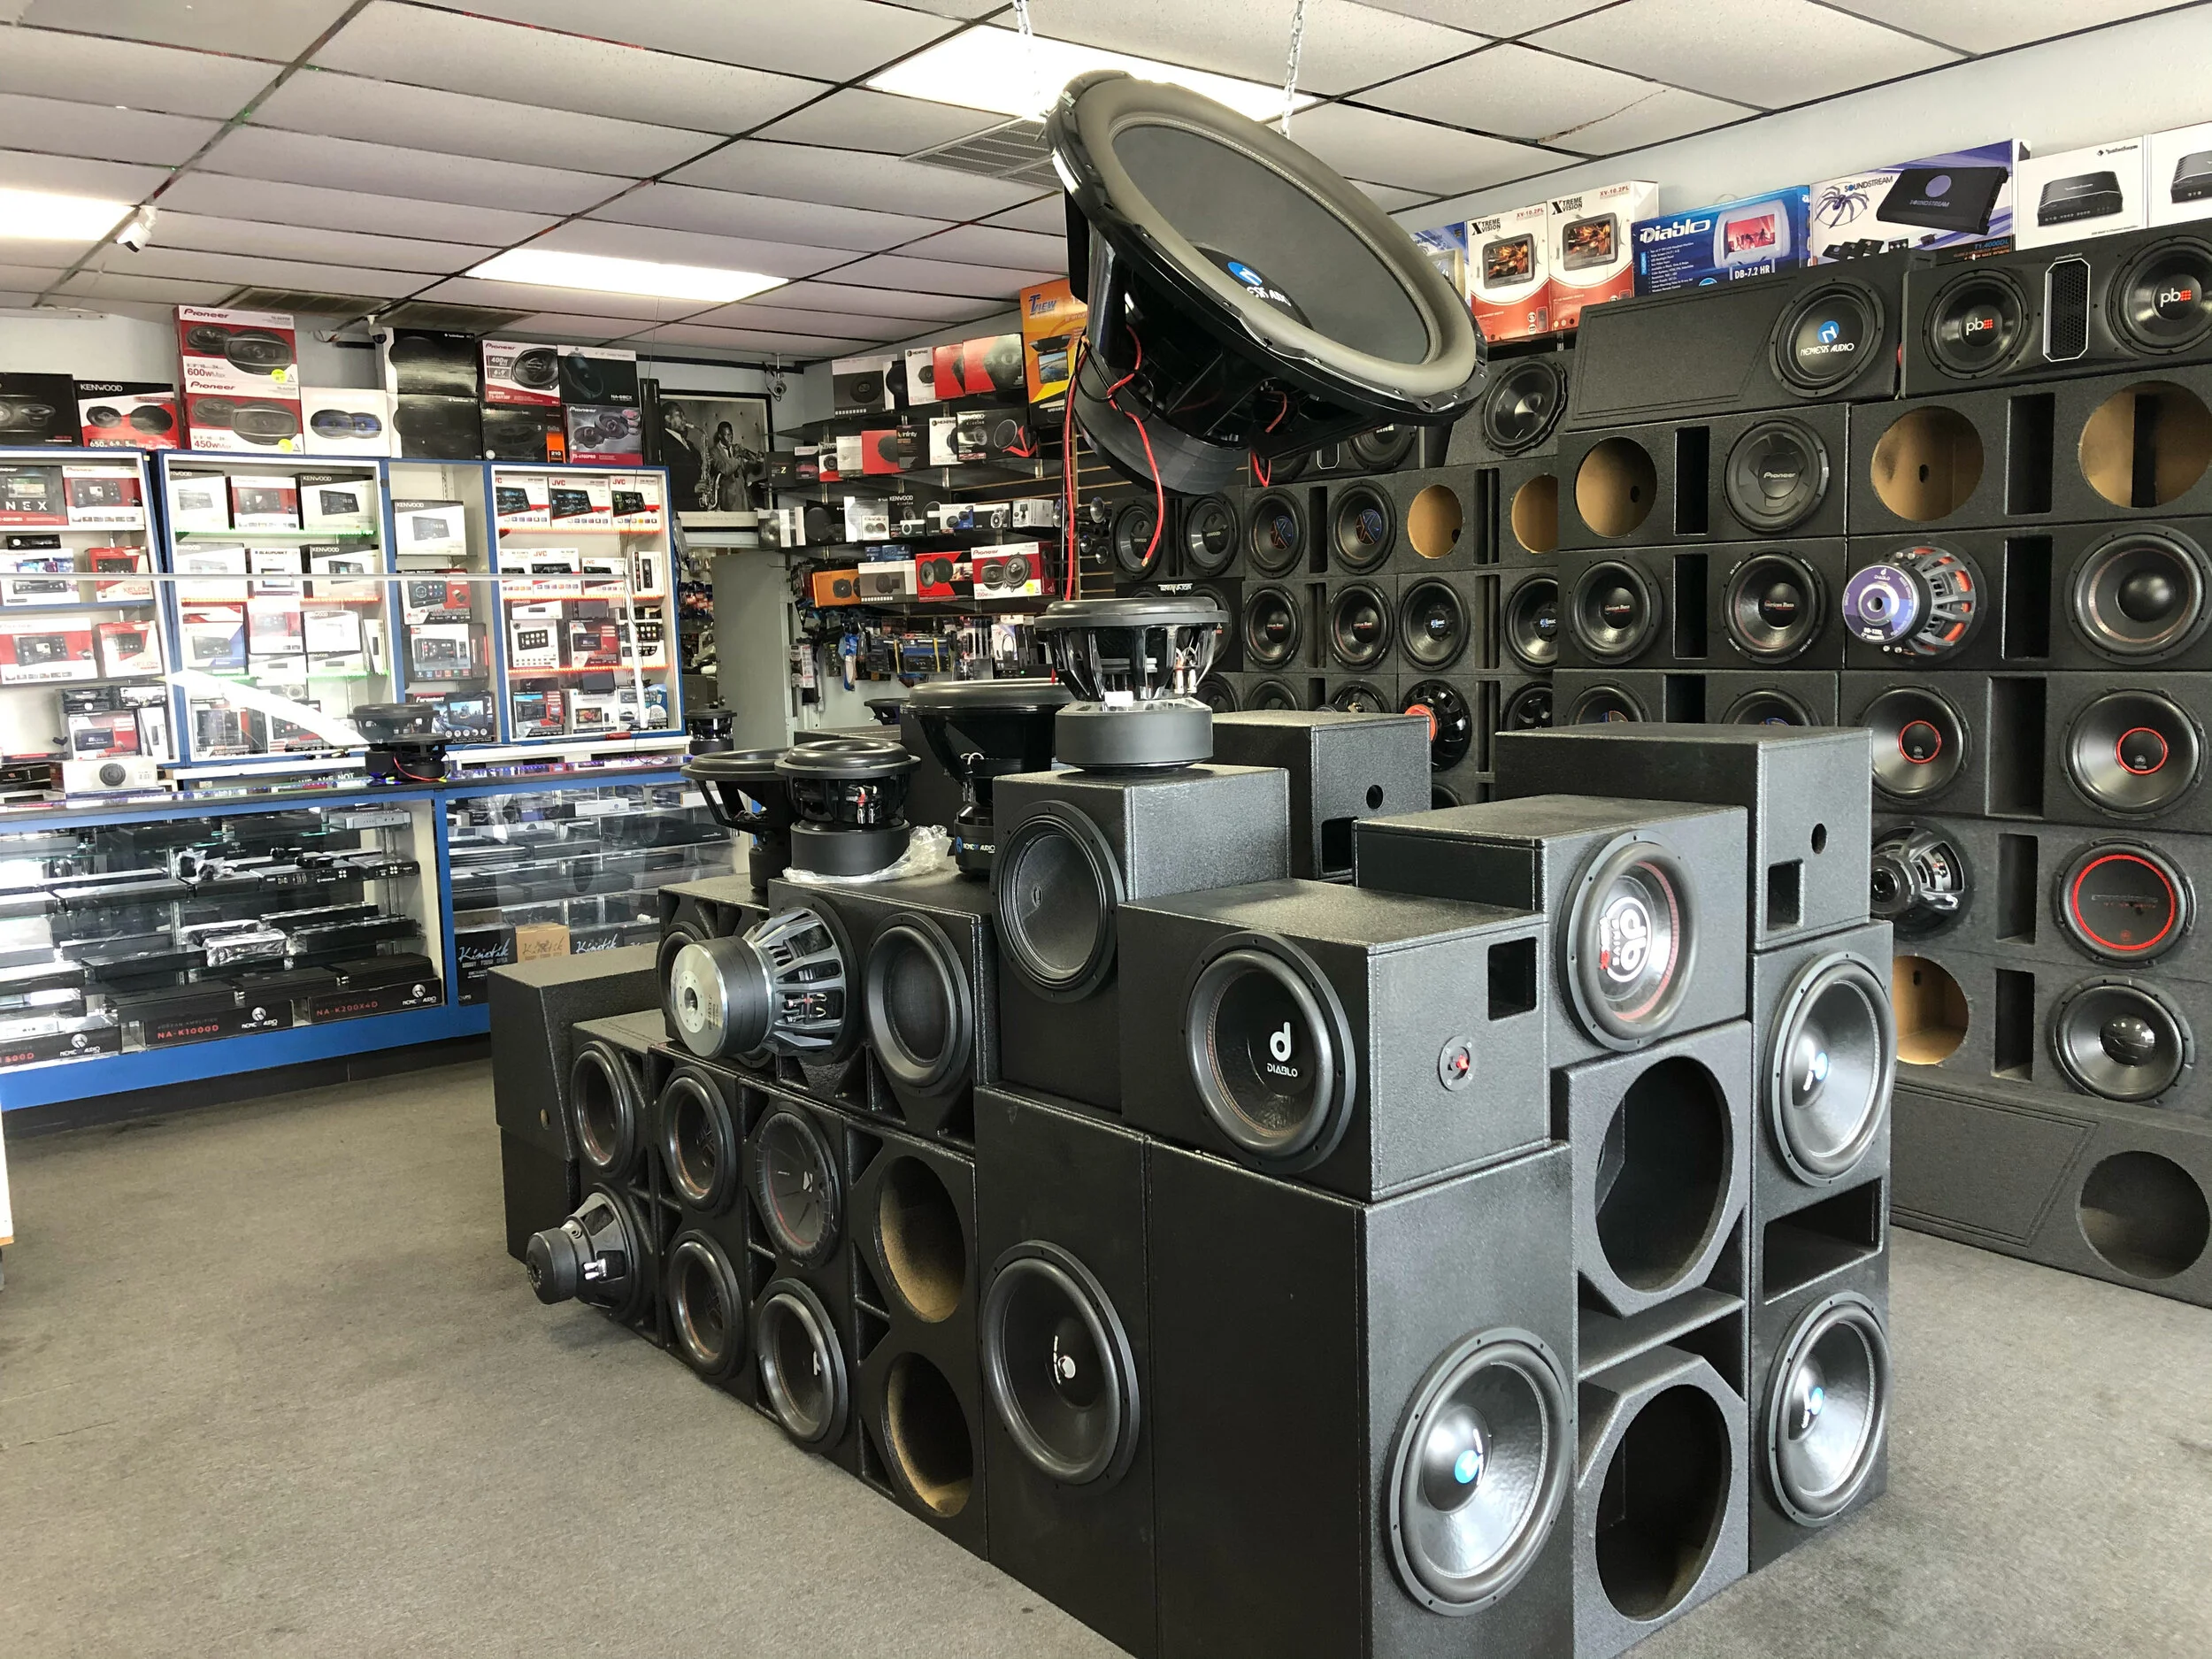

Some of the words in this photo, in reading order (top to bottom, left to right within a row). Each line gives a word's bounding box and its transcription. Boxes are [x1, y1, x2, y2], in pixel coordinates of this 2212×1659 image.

[1845, 176, 1893, 192] SOUNDSTREAM
[1563, 203, 1583, 211] VISION
[1640, 219, 1710, 243] Diablo
[1734, 266, 1758, 279] DB-7.2
[1760, 265, 1770, 273] HR
[184, 309, 229, 319] Pioneer
[1801, 345, 1829, 357] NEMESIS
[1831, 342, 1855, 353] AUDIO
[190, 381, 235, 390] Pioneer
[458, 938, 511, 962] Kinetik
[576, 933, 618, 954] Kinetik
[157, 1025, 219, 1039] NA-K1000D
[1267, 1063, 1298, 1077] DIABLO
